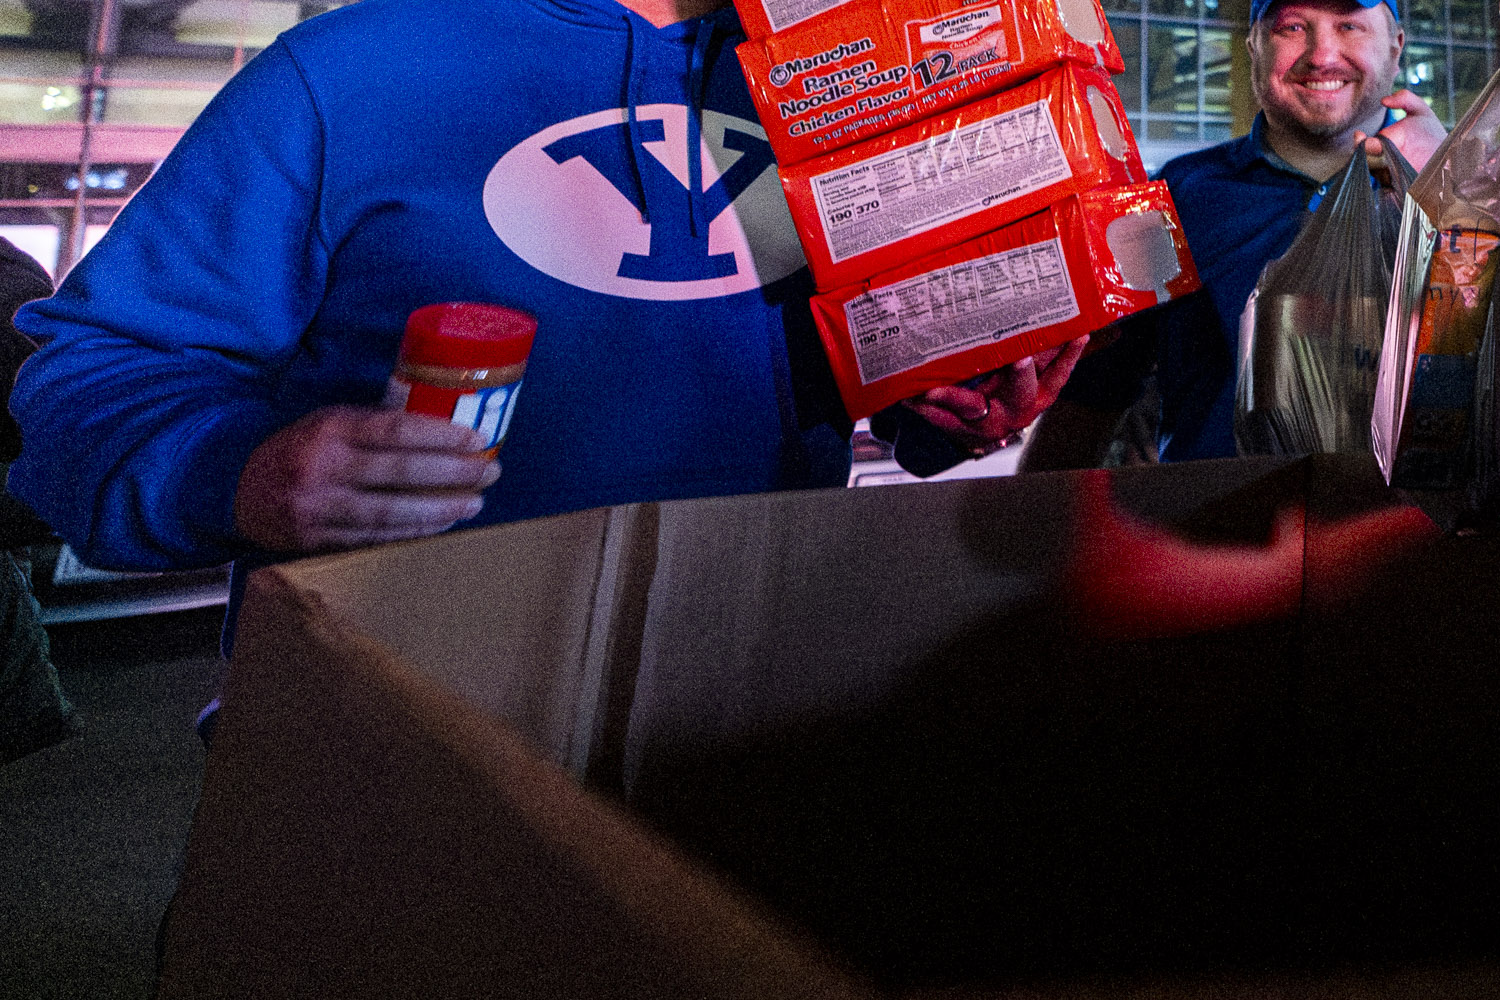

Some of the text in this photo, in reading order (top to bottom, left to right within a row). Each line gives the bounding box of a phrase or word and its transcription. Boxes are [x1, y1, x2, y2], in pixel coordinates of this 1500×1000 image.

[941, 10, 989, 29] Maruchan
[786, 37, 871, 74] Maruchan
[910, 46, 1000, 89] 12 PACK
[780, 65, 908, 118] Noodle Soup
[804, 61, 876, 95] Ramen
[788, 86, 911, 137] Chicken Flavor
[819, 165, 870, 187] Nutrition Facts
[988, 185, 1021, 201] Maruchan
[541, 118, 779, 284] Y
[829, 200, 880, 225] 190 370
